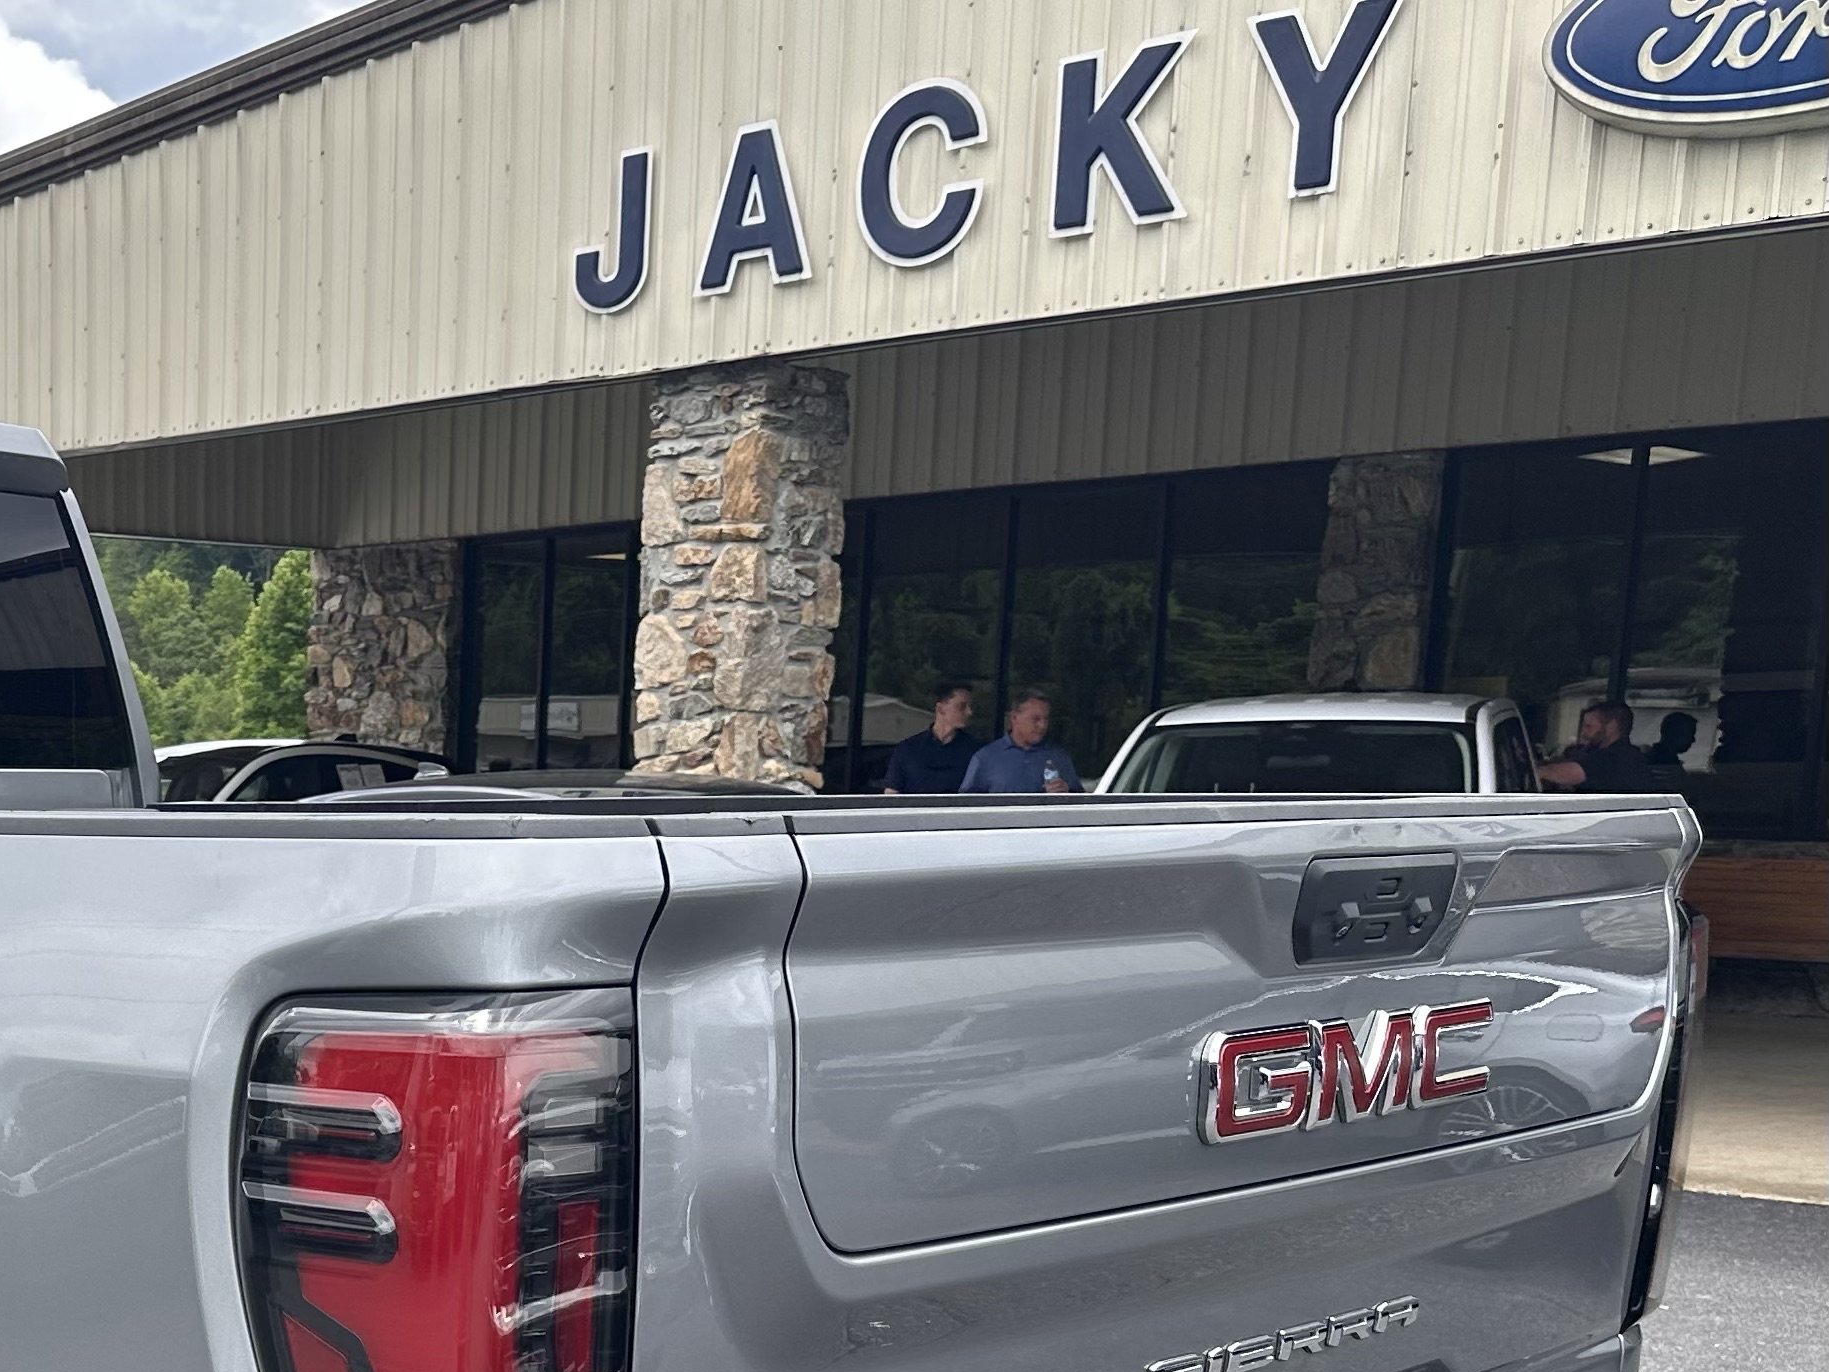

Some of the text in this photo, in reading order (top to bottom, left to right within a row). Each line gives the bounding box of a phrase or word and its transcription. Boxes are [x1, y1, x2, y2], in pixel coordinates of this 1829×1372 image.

[1637, 0, 1829, 82] For
[574, 0, 1402, 313] JACKY
[1194, 997, 1494, 1145] GMC
